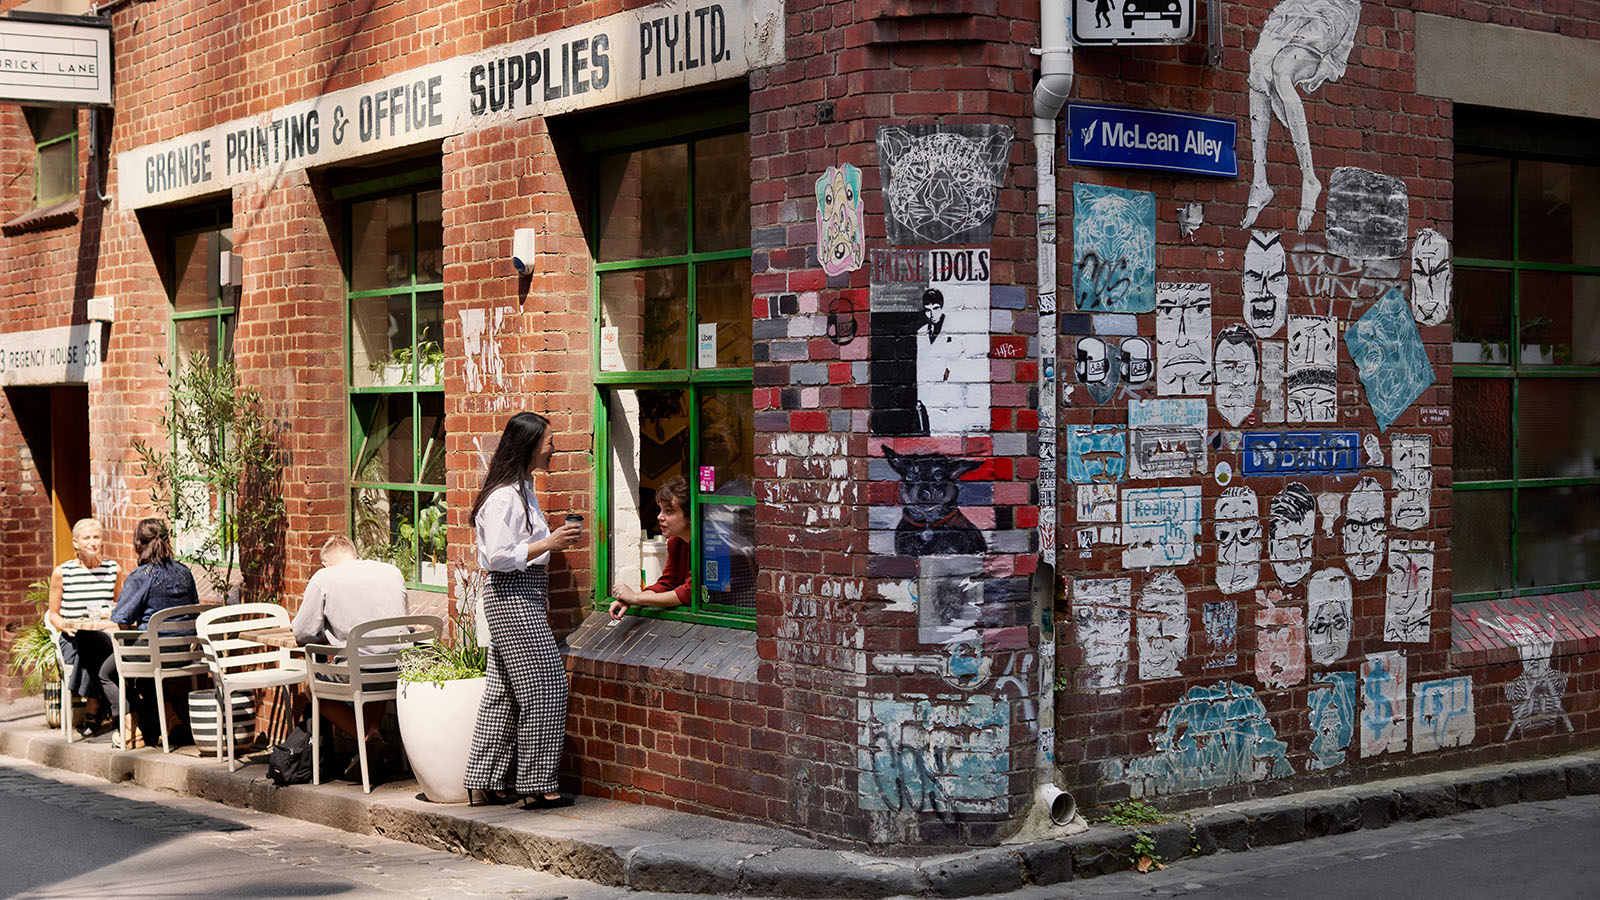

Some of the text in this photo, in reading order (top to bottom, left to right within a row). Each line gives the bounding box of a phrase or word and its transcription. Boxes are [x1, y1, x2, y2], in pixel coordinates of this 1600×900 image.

[0, 58, 95, 74] RICK LANE
[145, 3, 731, 194] GRANGE PRINTING & OFFICE SUPPLIES PTY.LTD.
[1101, 121, 1223, 163] McLean Alley
[872, 250, 990, 283] FALSE IDOLS
[700, 334, 713, 342] Uber
[700, 342, 713, 350] Eats
[9, 347, 46, 369] REGENCY
[49, 345, 79, 366] HOUSE
[83, 339, 97, 367] 33
[1134, 499, 1181, 518] Reality
